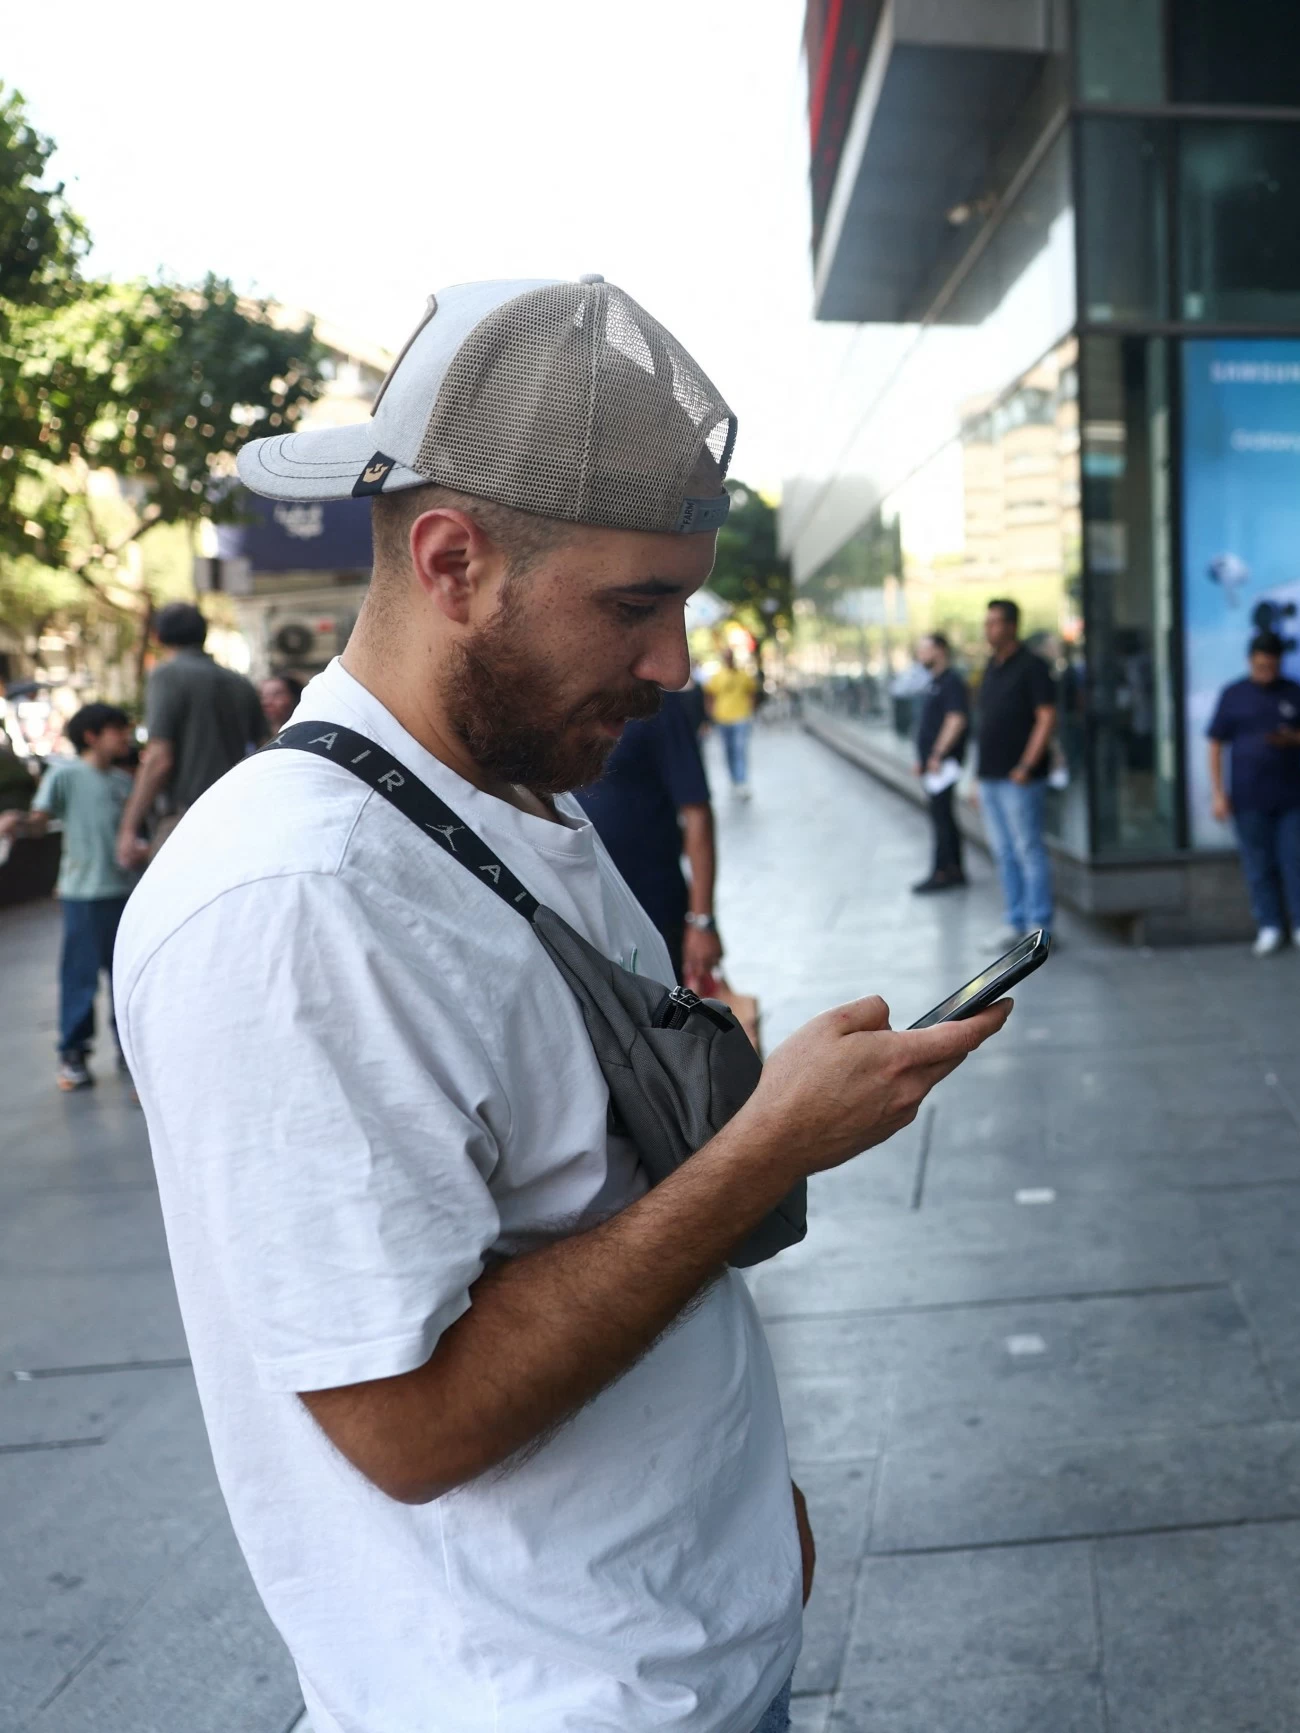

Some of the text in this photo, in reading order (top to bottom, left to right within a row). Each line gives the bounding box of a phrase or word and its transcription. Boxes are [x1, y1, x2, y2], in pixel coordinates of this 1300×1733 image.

[683, 501, 697, 525] FARM
[308, 731, 527, 902] AIR AI
